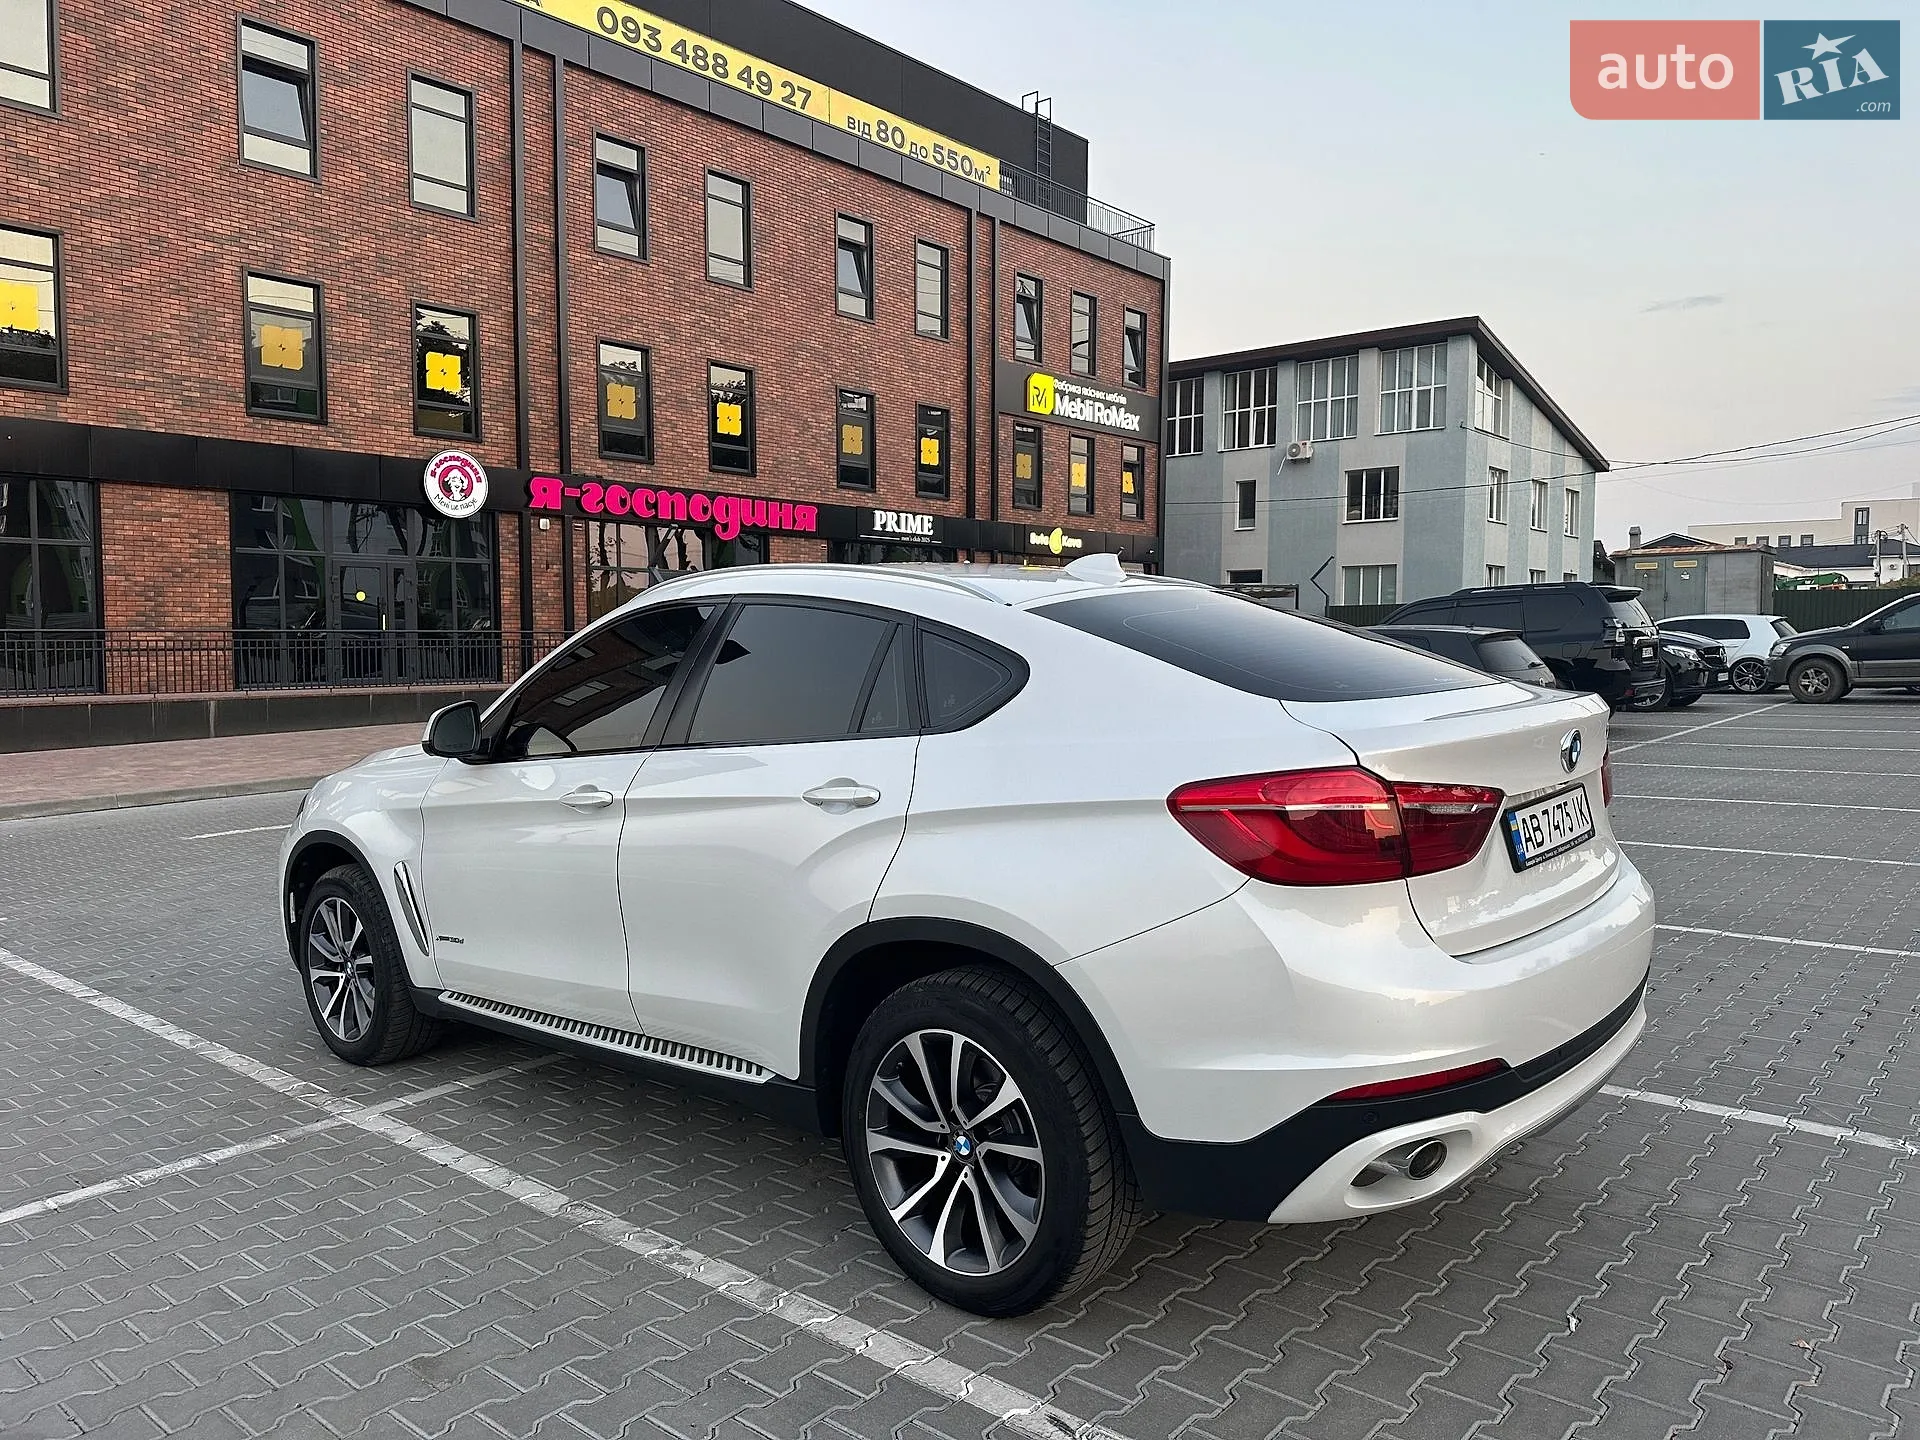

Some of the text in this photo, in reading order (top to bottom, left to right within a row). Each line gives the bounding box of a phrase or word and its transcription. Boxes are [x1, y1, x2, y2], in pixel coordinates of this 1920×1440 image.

[596, 6, 812, 110] 093 488 49 27
[875, 119, 905, 149] 80
[873, 509, 934, 536] PRIME
[1521, 813, 1545, 853] AB
[1541, 800, 1574, 844] 7475
[1571, 793, 1590, 829] IK
